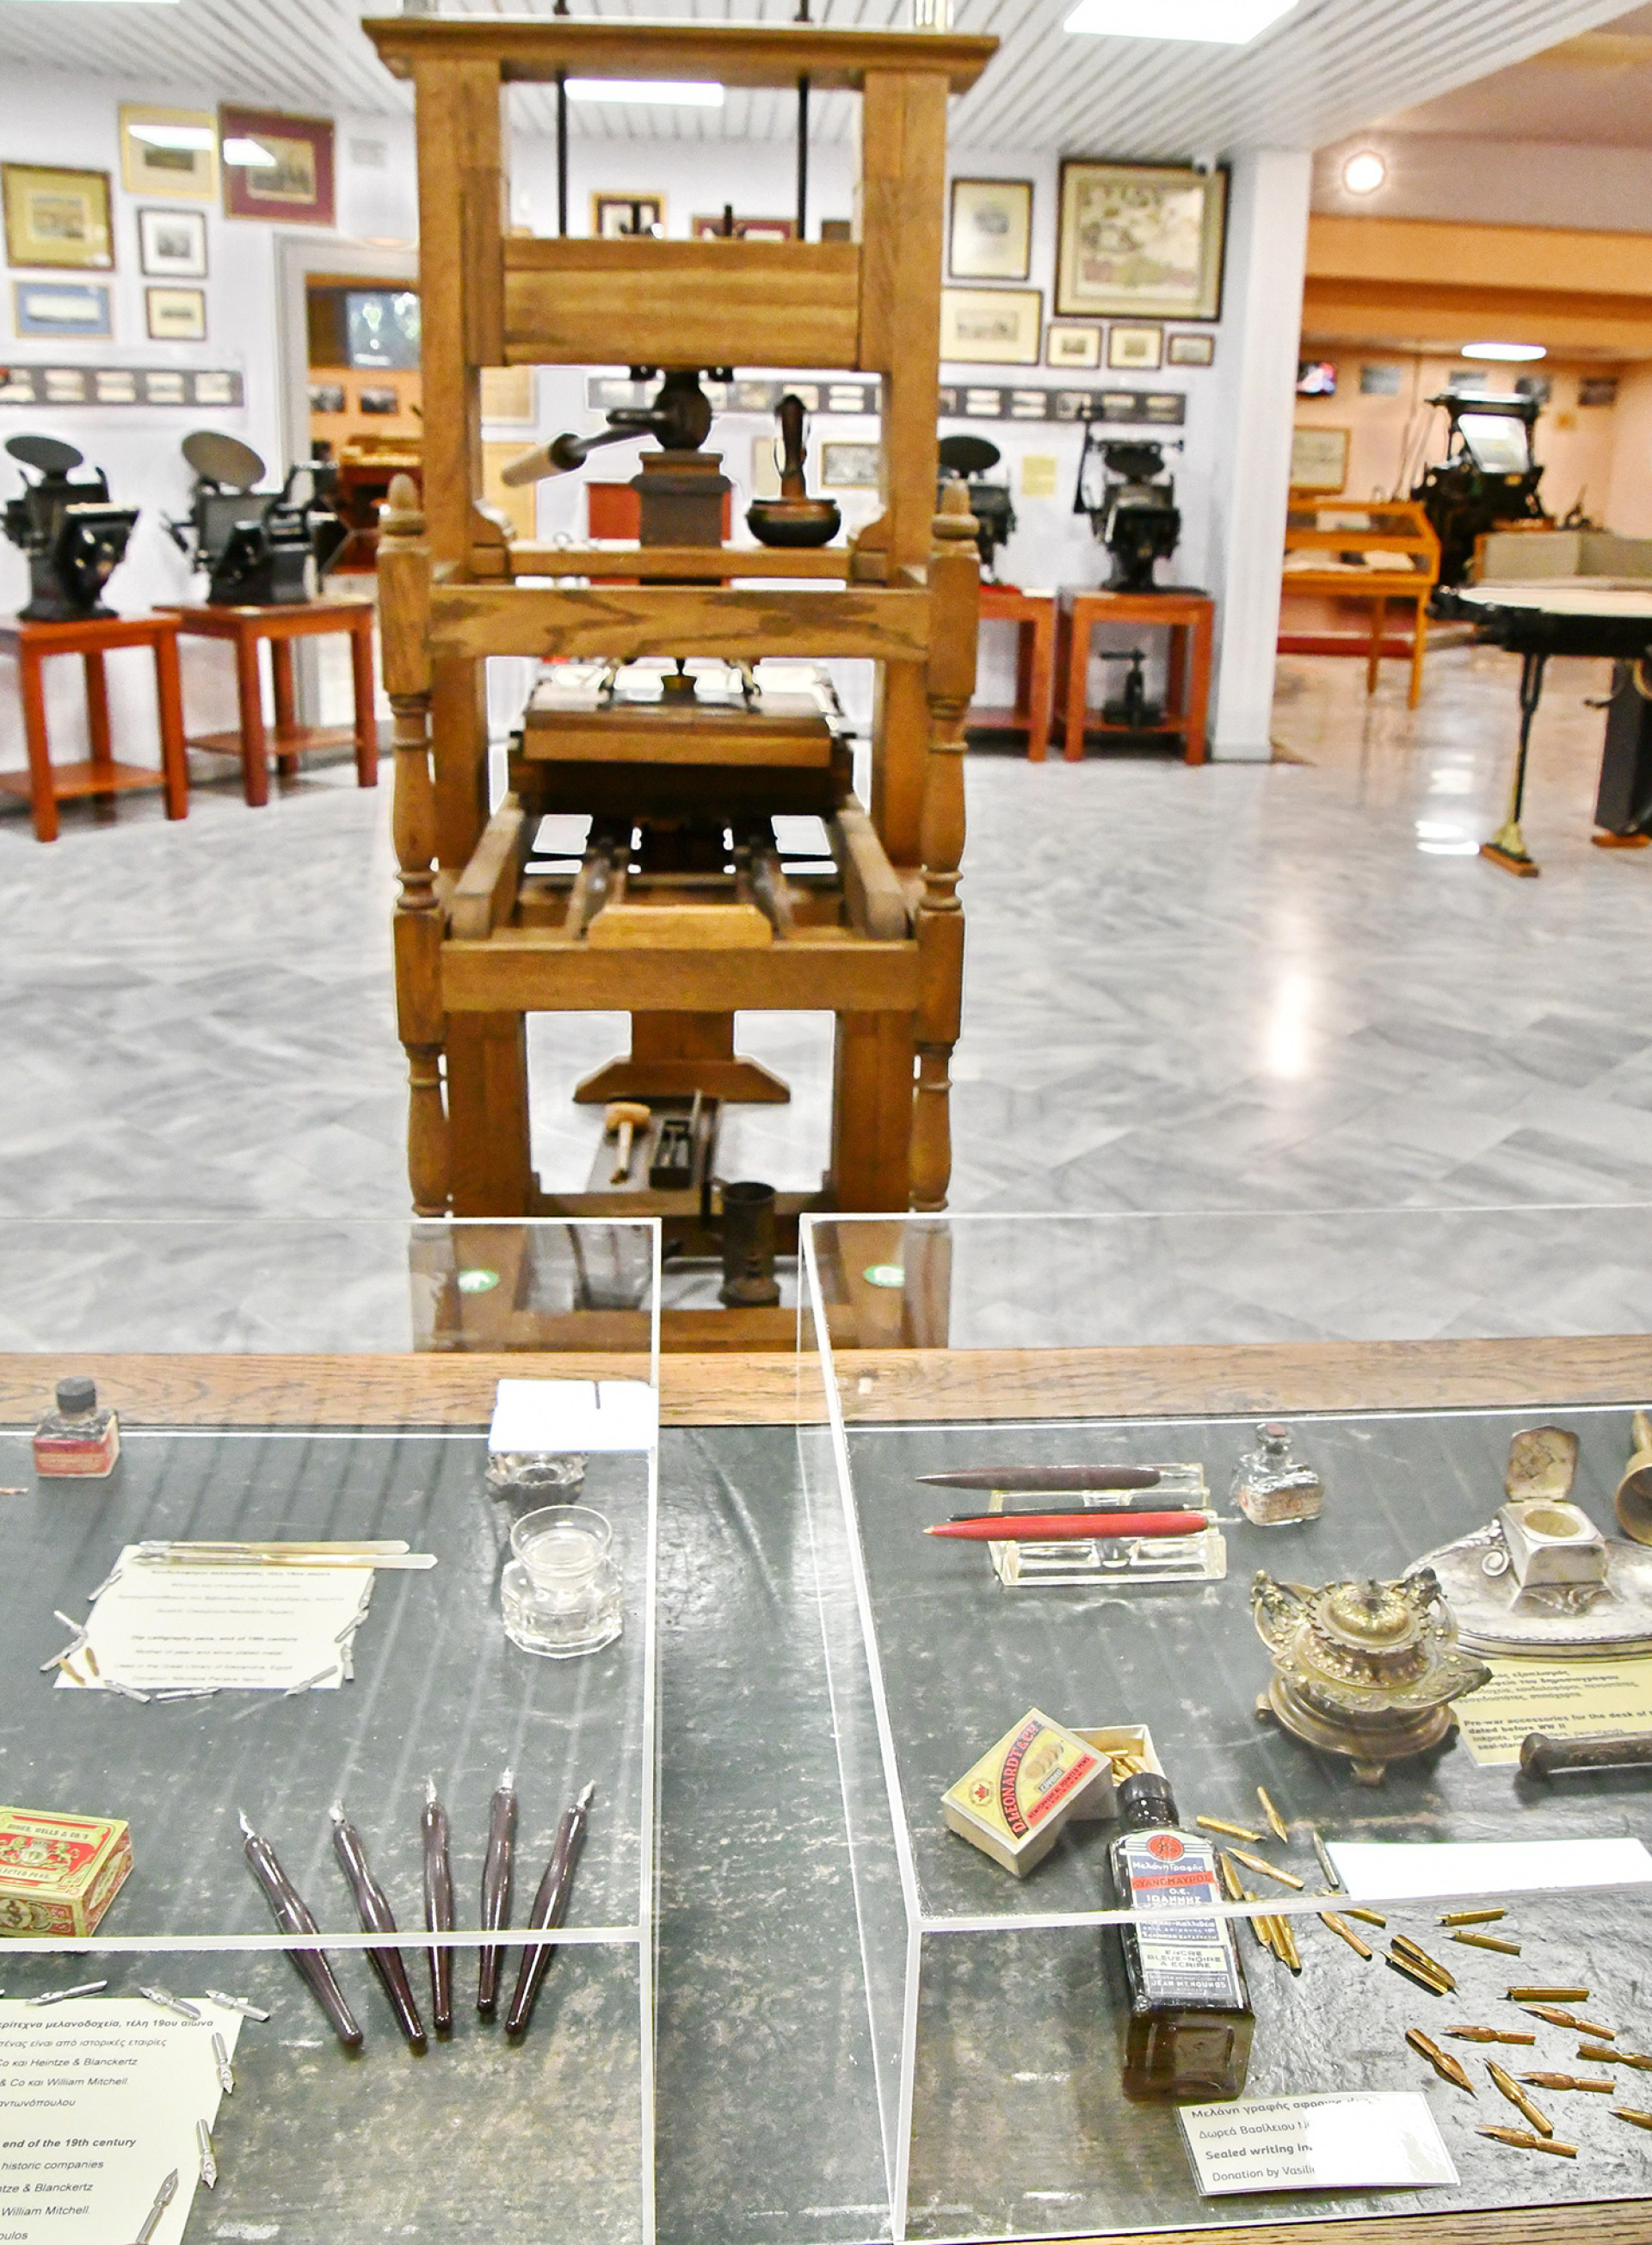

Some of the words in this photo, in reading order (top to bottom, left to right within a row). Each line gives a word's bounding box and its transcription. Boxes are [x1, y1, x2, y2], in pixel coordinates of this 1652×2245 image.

[1002, 1747, 1026, 1823] LEONARDT
[1147, 1953, 1222, 1963] BLEUE-NOIRE
[30, 2057, 71, 2067] Heintze
[72, 2057, 81, 2066] &
[83, 2057, 138, 2067] Blanckertz
[10, 2078, 26, 2088] Co
[46, 2077, 84, 2087] William
[1191, 2107, 1241, 2119] Μελάνη
[1242, 2100, 1290, 2115] γραφής
[1199, 2128, 1237, 2140] Δωρεά
[1240, 2122, 1296, 2136] Βασίλειου
[3, 2138, 26, 2149] end
[28, 2138, 40, 2149] of
[42, 2138, 61, 2148] the
[65, 2138, 89, 2148] 19th
[92, 2137, 138, 2149] century
[1205, 2147, 1247, 2161] Sealed
[1249, 2143, 1294, 2156] writing
[1, 2161, 42, 2170] historic
[44, 2160, 105, 2171] companies
[1211, 2169, 1264, 2183] Donation
[1267, 2168, 1280, 2180] by
[22, 2183, 32, 2193] &
[34, 2182, 95, 2193] Blanckertz
[2, 2205, 42, 2217] William
